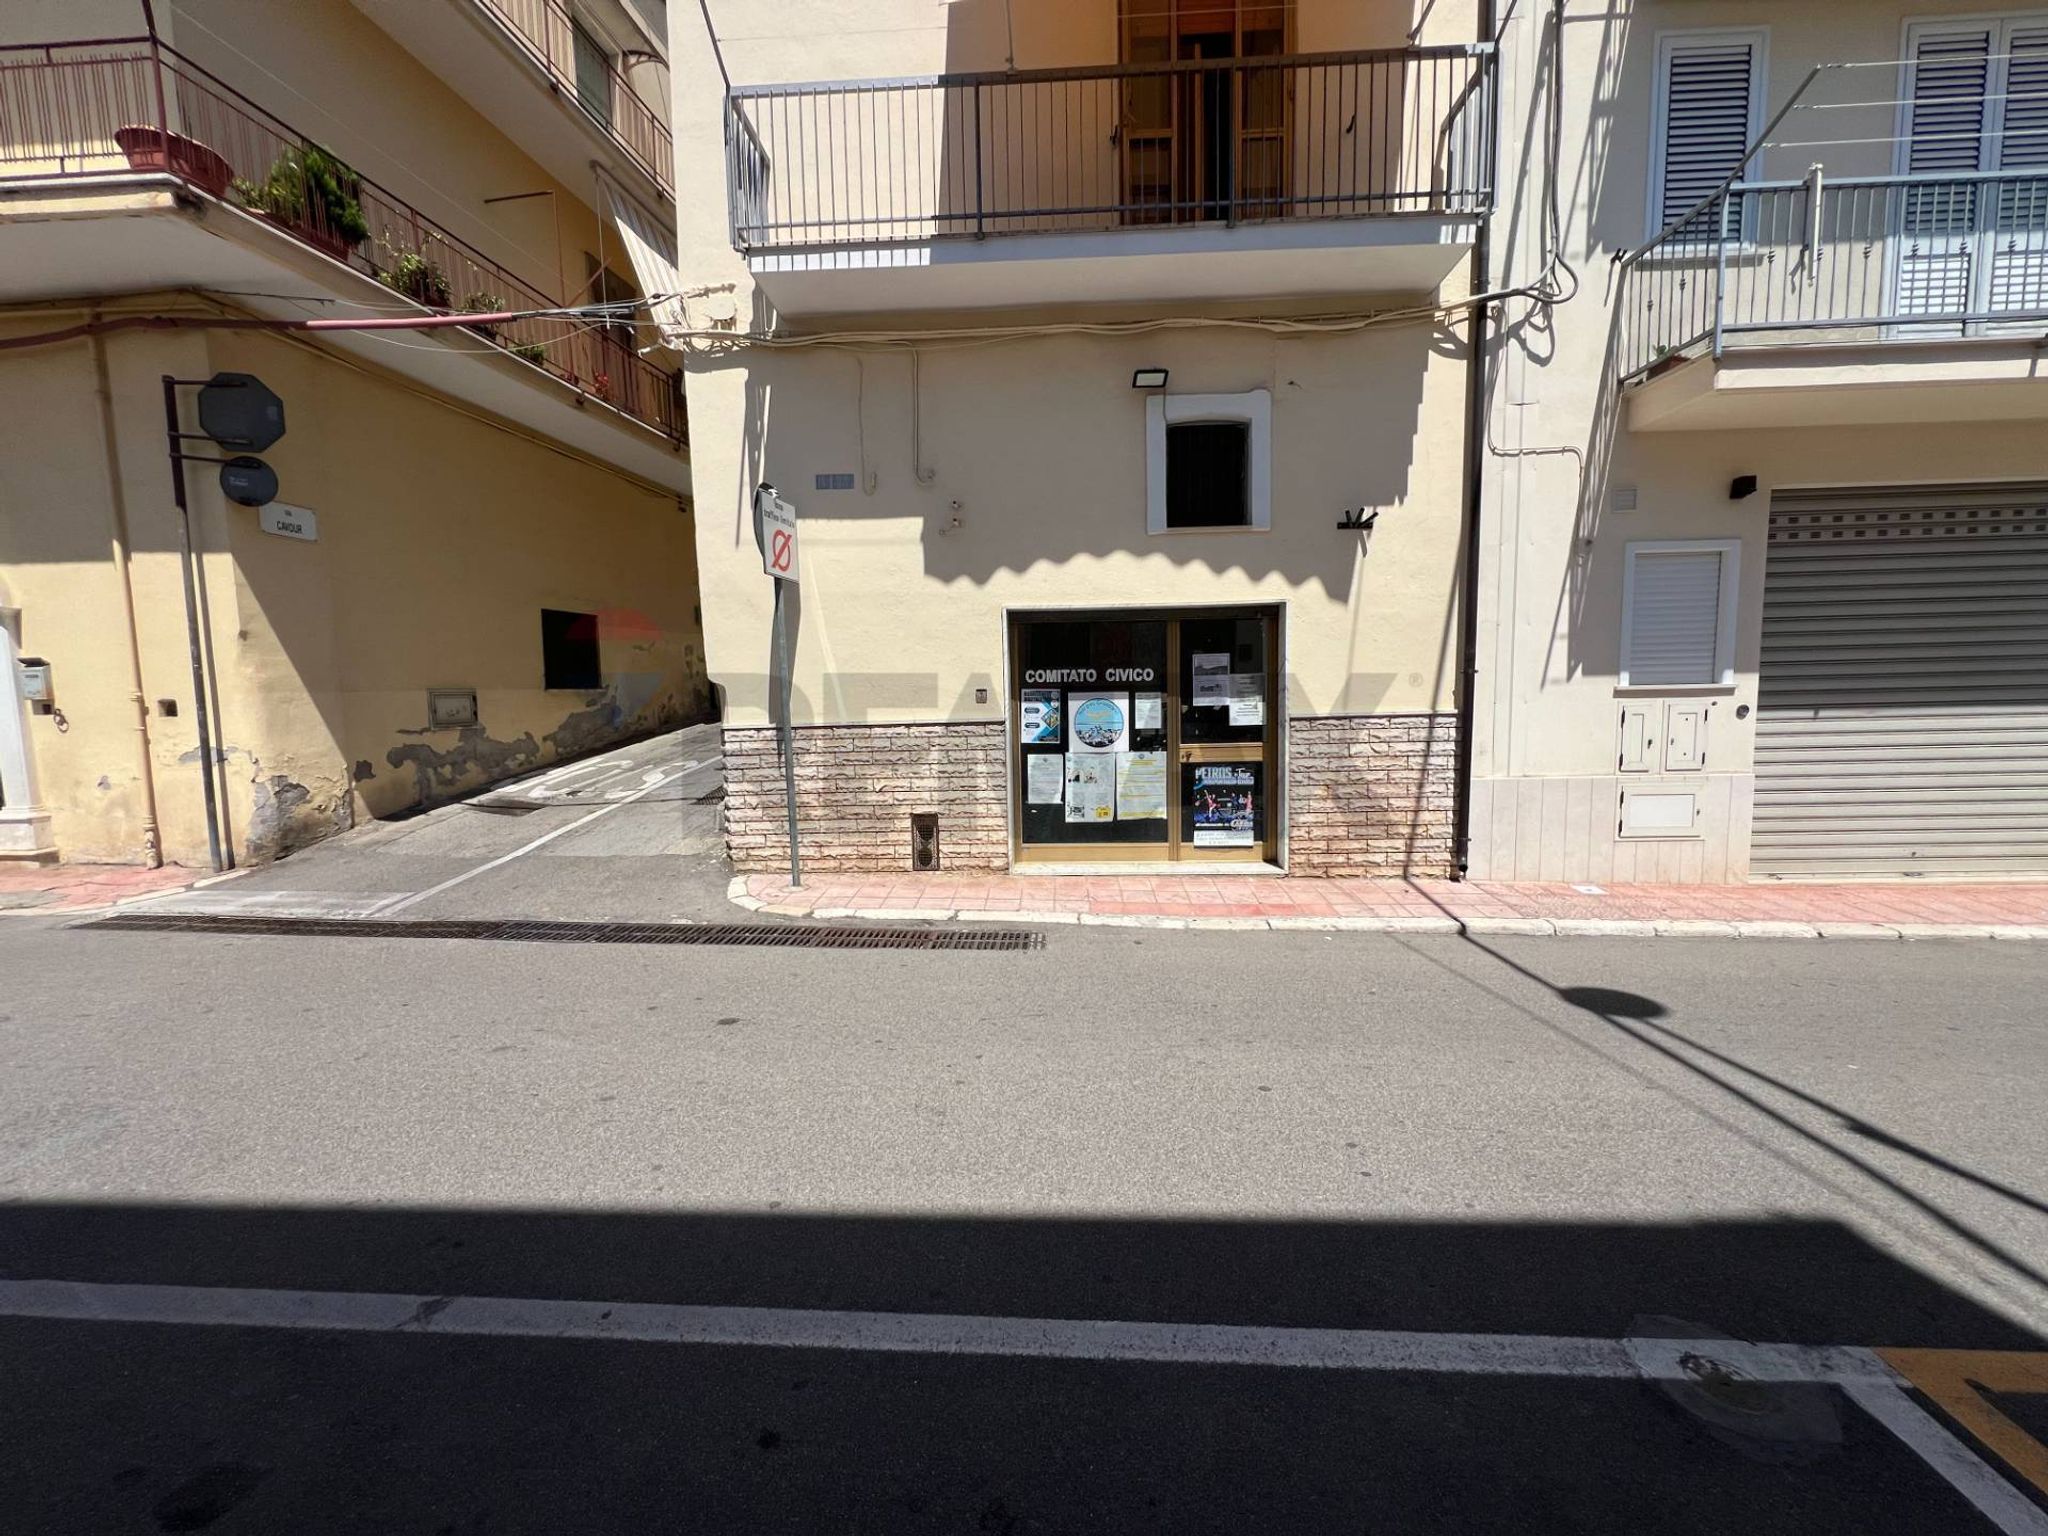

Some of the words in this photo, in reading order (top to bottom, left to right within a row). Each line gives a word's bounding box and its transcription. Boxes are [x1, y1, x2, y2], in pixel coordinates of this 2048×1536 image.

[276, 520, 302, 534] CAVOUR
[1025, 669, 1097, 683] COMITATO
[1105, 668, 1154, 682] CIVICO
